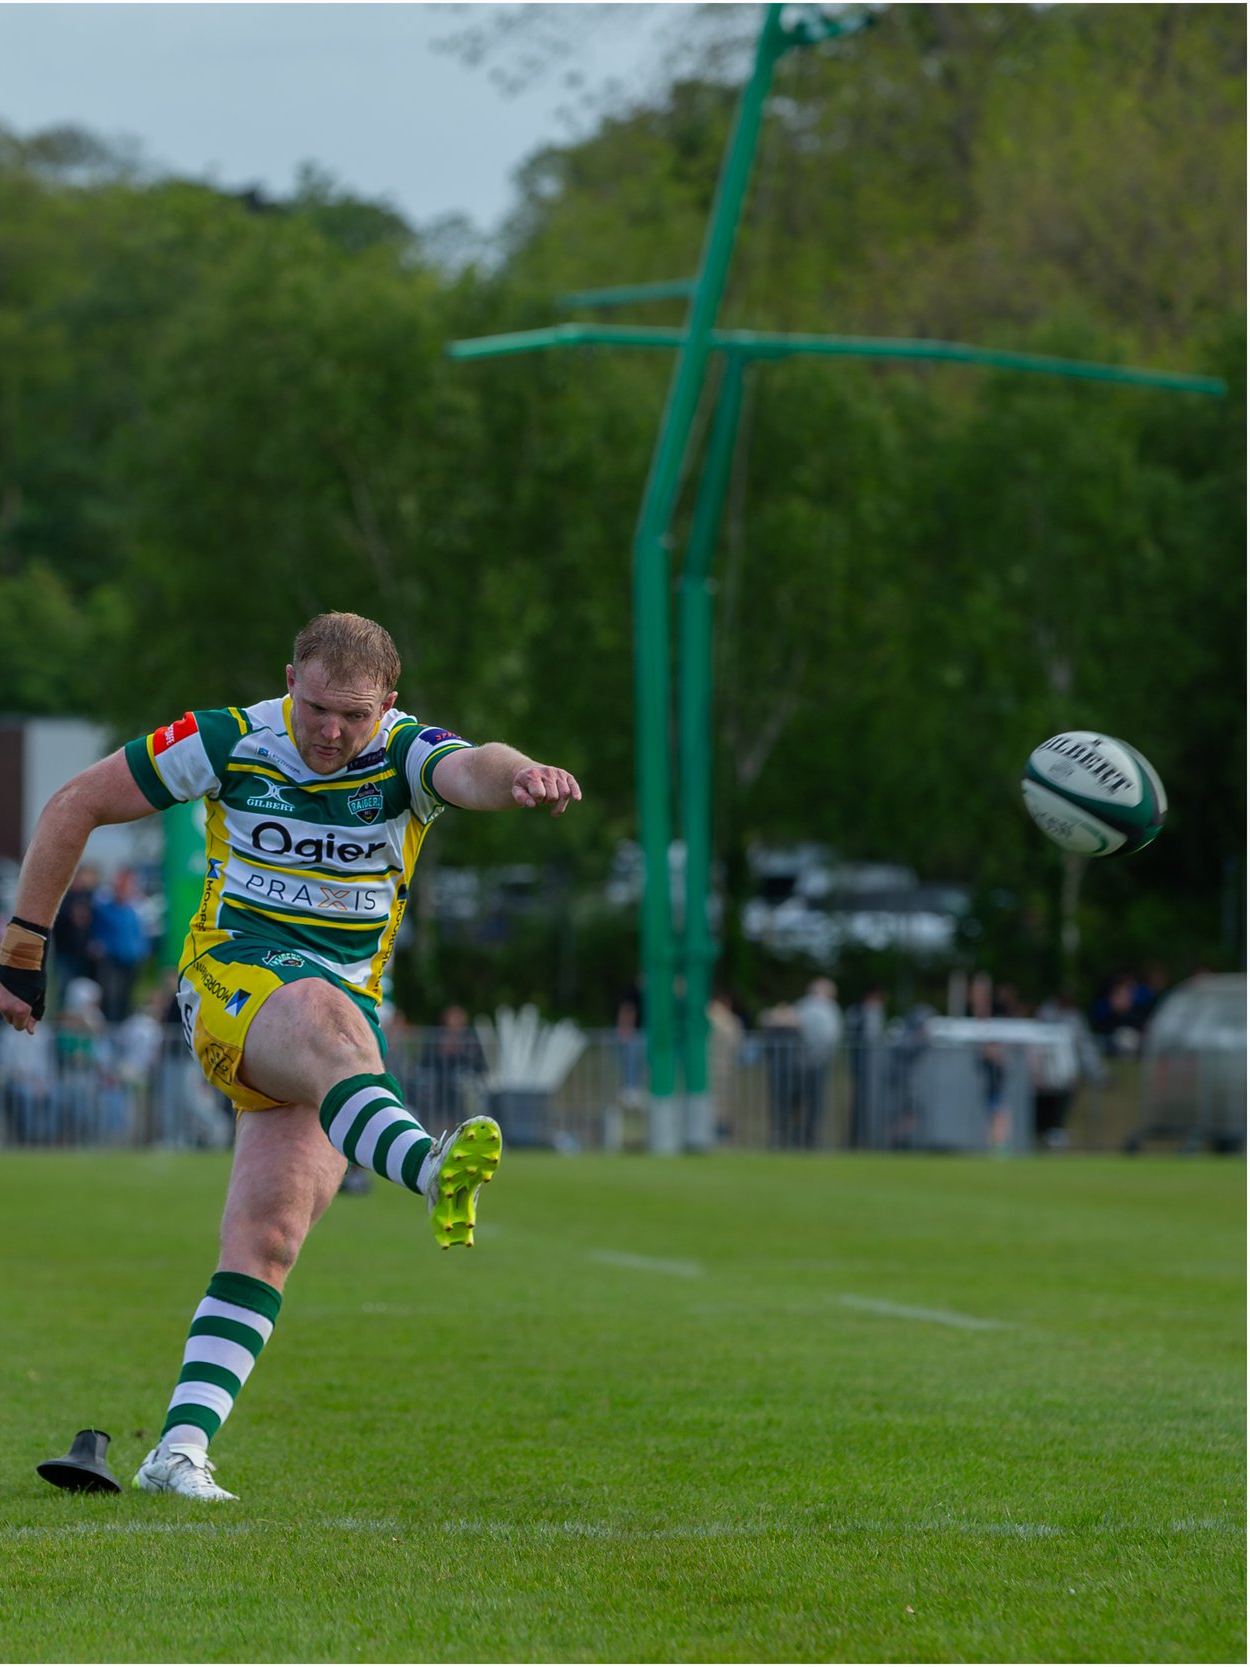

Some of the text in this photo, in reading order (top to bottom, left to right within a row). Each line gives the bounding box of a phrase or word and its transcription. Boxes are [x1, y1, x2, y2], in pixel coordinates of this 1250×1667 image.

[246, 798, 296, 812] GILBERT
[251, 821, 387, 865] Ogier
[246, 874, 377, 911] PRAXIS
